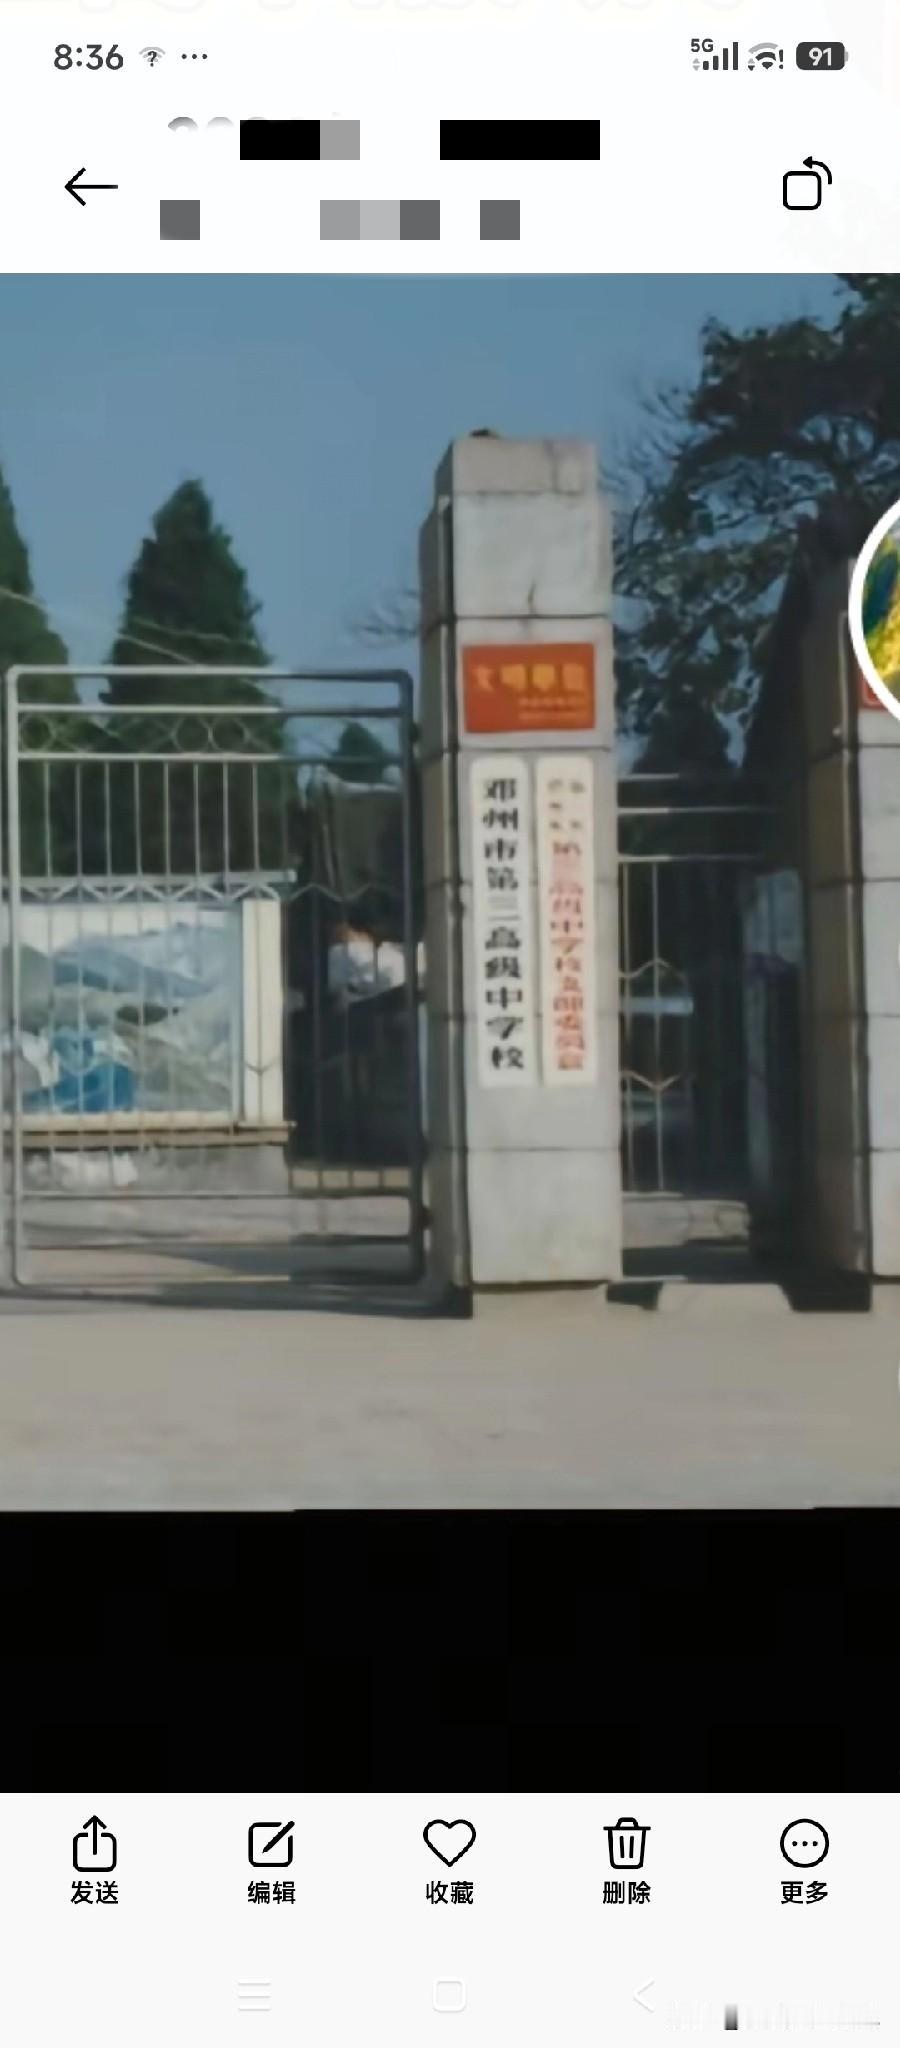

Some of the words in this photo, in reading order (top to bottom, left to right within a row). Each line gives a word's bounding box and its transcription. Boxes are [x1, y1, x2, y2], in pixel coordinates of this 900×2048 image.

[54, 44, 124, 71] 8:36
[691, 38, 714, 53] 5G
[808, 47, 832, 67] 91
[483, 778, 523, 1069] 邓州市第三高级中学校
[70, 1880, 119, 1905] 发送
[247, 1880, 296, 1905] 编辑
[425, 1880, 474, 1905] 收藏
[602, 1880, 652, 1905] 删除
[780, 1880, 829, 1905] 更多
